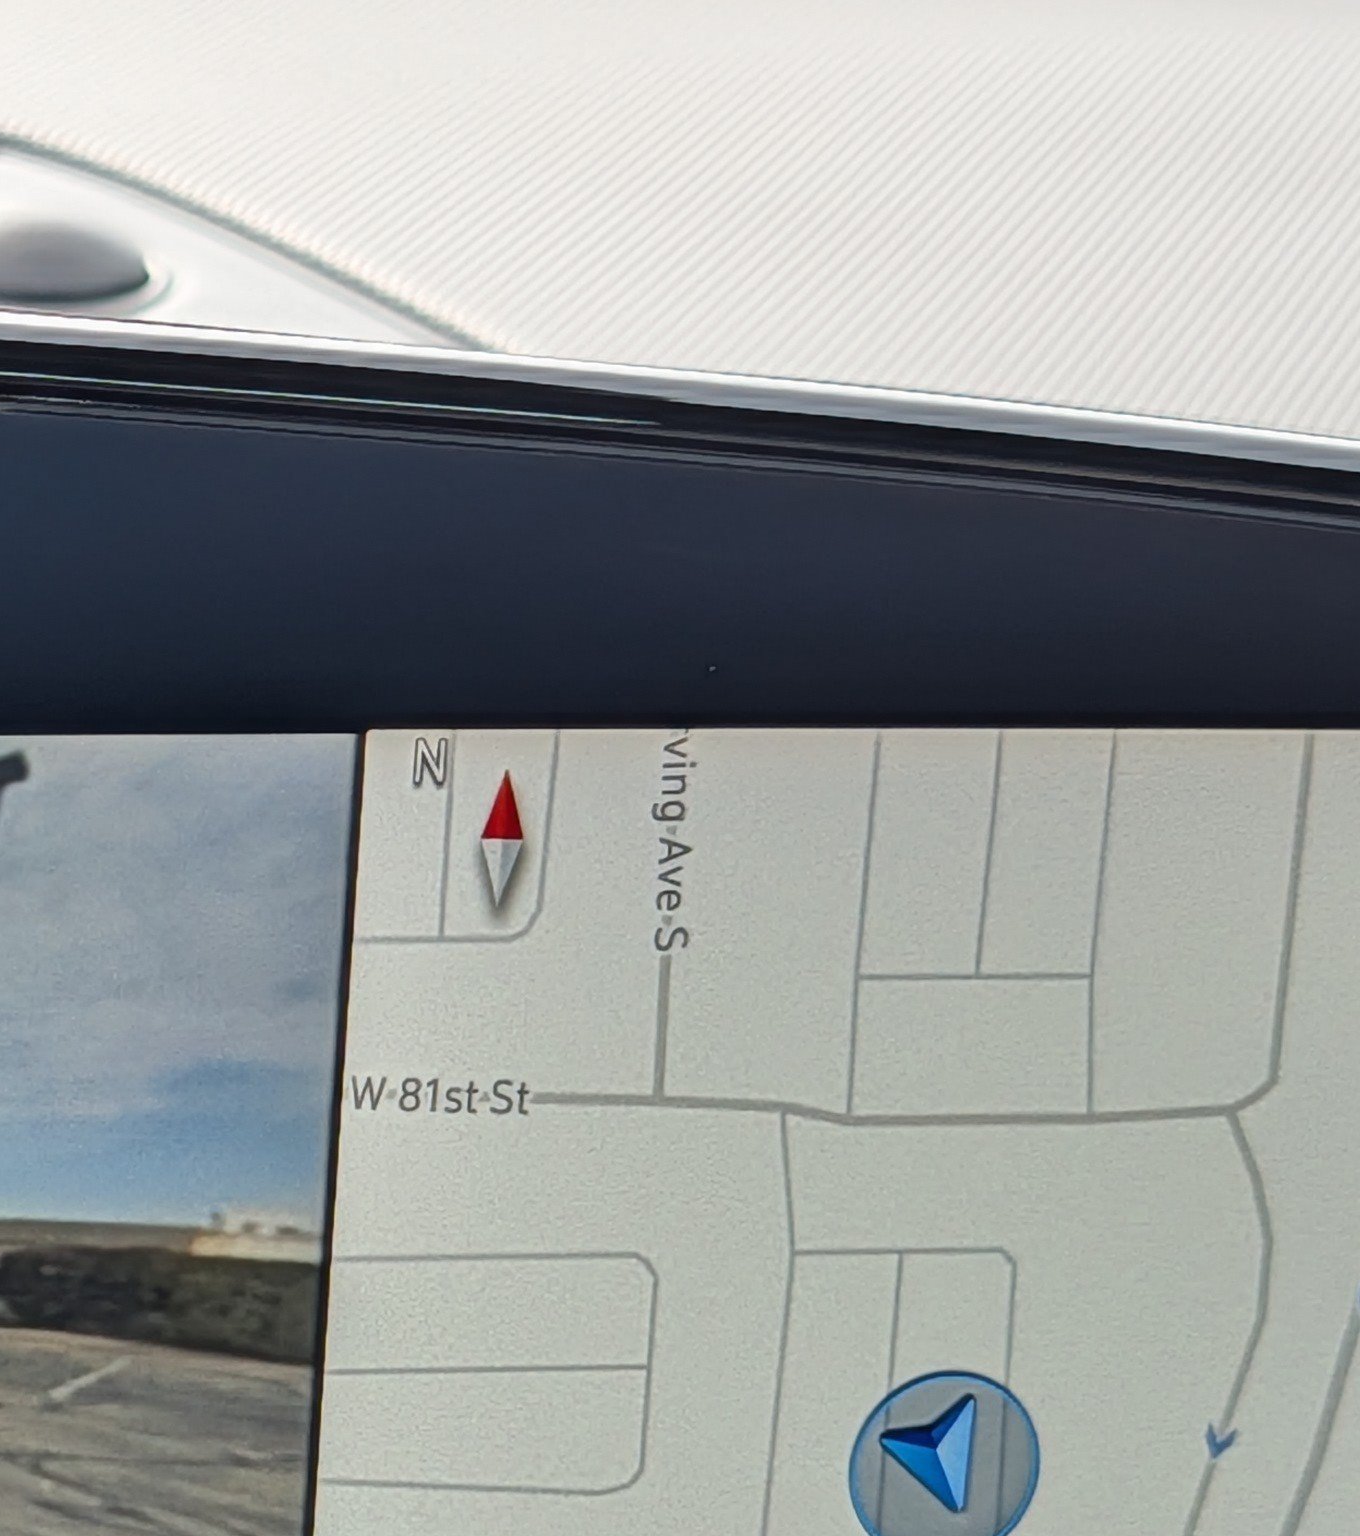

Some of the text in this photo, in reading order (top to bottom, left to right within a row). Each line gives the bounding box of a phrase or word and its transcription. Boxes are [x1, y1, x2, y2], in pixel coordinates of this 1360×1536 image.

[412, 737, 448, 788] N
[651, 728, 698, 953] ving Ave S
[352, 1076, 530, 1115] W 81st St
